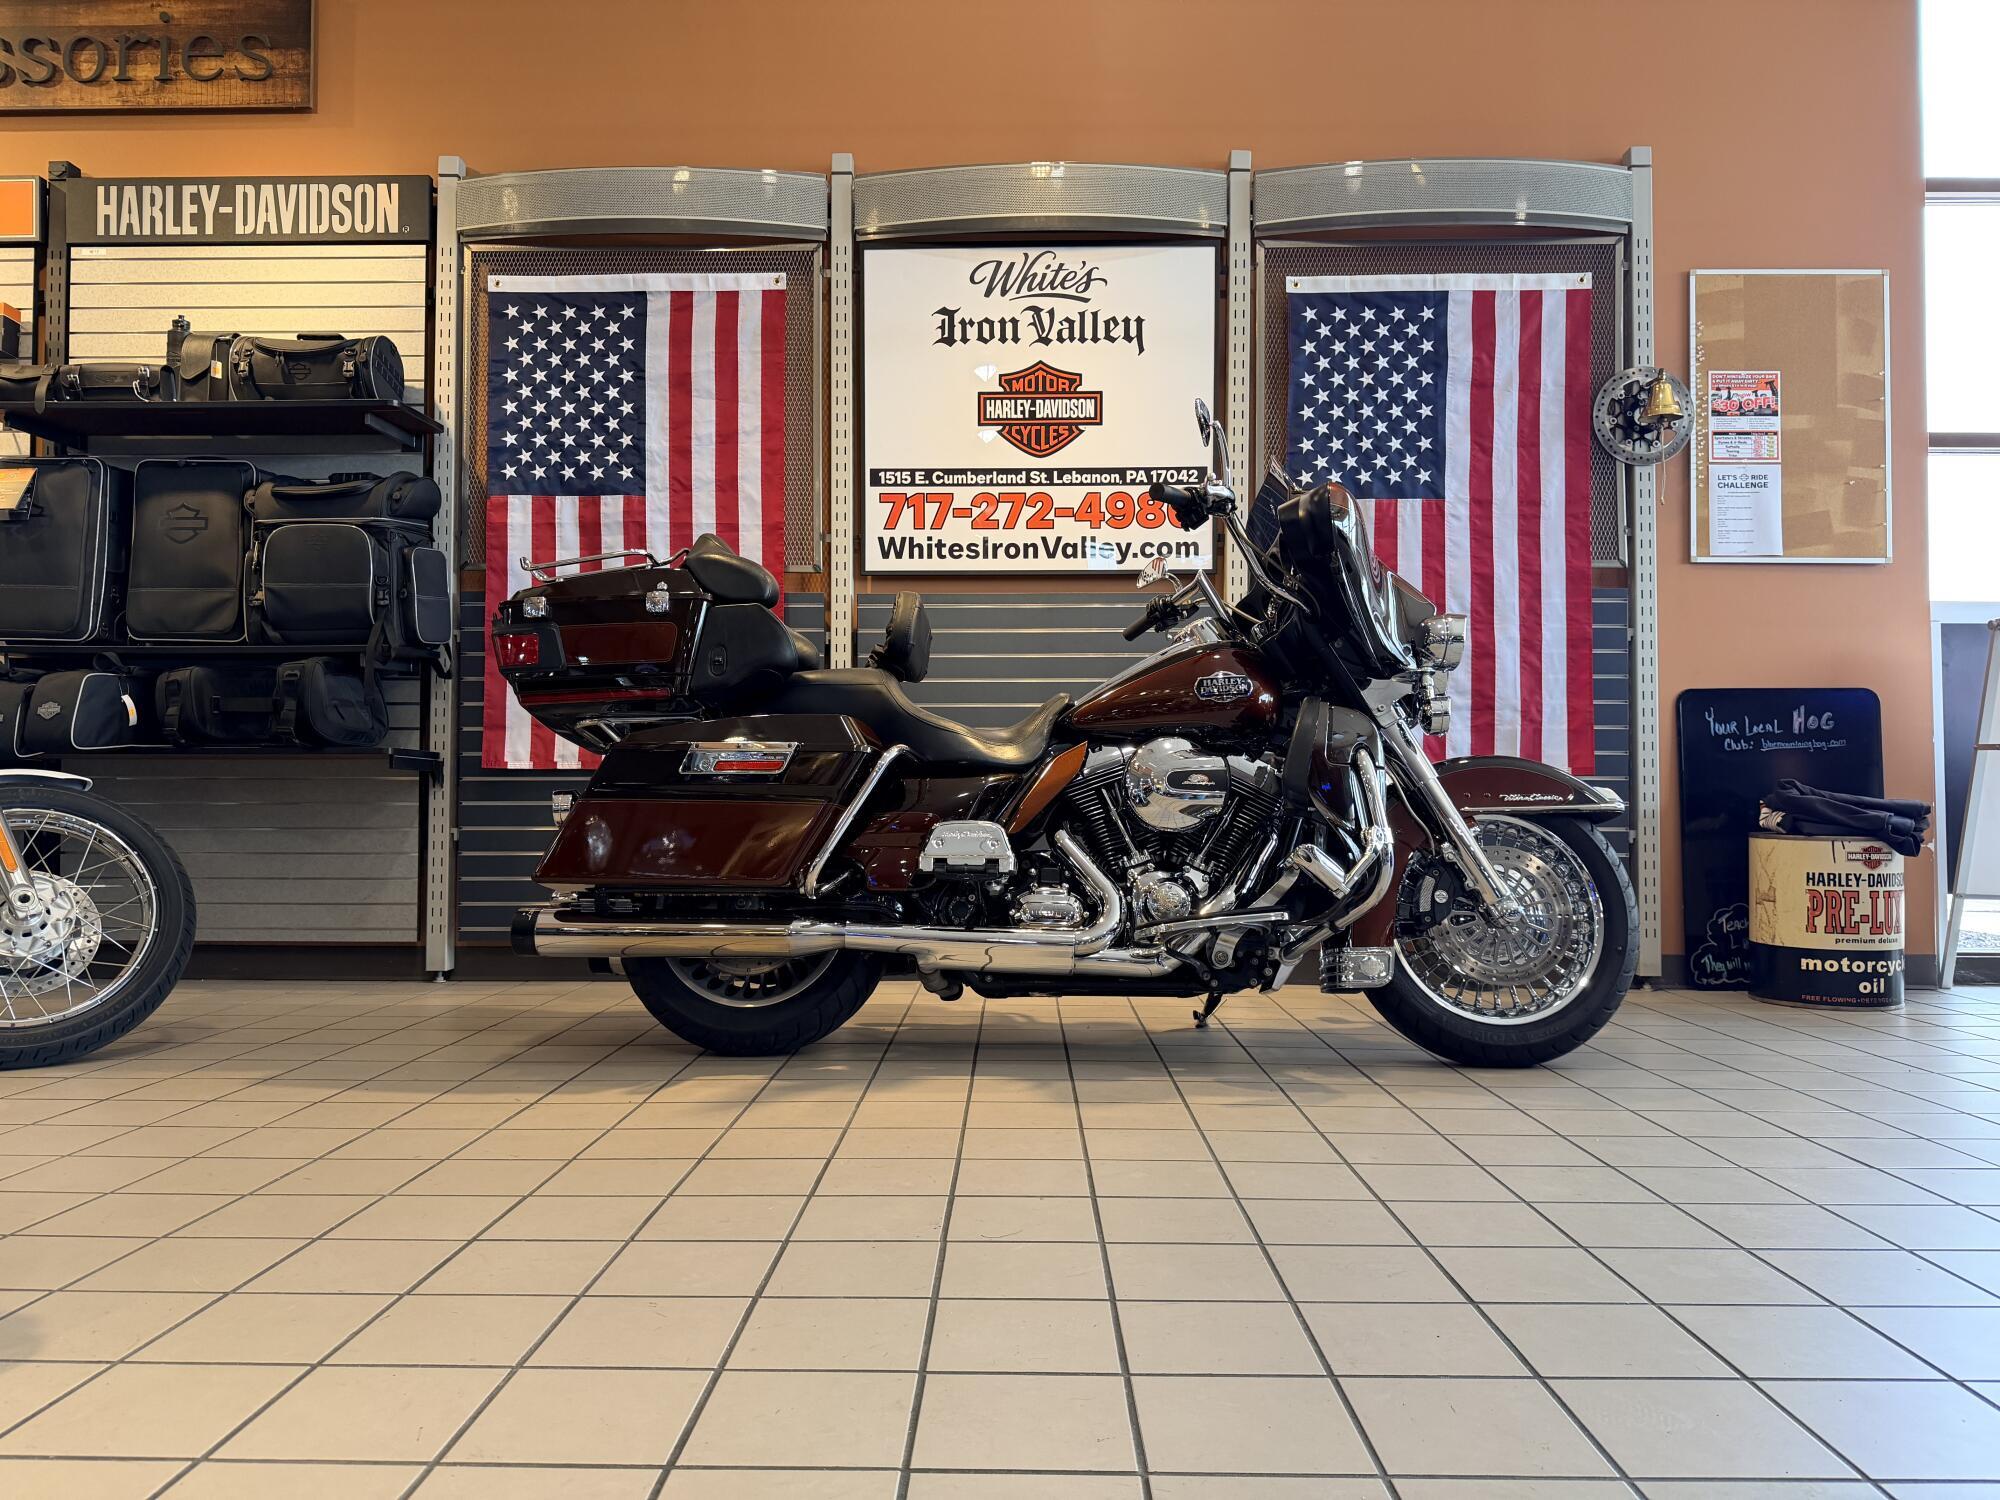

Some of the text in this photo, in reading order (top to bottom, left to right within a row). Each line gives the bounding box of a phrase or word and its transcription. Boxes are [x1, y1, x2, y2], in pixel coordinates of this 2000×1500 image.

[97, 184, 399, 235] HARLEY-DAVIDSON
[969, 250, 1108, 301] White's
[931, 305, 1146, 356] Iron Valley
[1012, 370, 1069, 392] MOTOR
[986, 399, 1095, 419] HARLEY-DAVIDSON
[1741, 395, 1776, 411] OFF!
[1012, 425, 1069, 450] CYCLES
[879, 469, 1199, 484] 1515 E. Cumberland St. Lebanon, PA 17042
[1717, 481, 1769, 489] CHALLENGE
[878, 536, 1200, 564] WhitesIronValley.com
[1201, 684, 1248, 694] DAVIDSON
[1858, 978, 1885, 994] oil
[1801, 994, 1821, 1002] FREE
